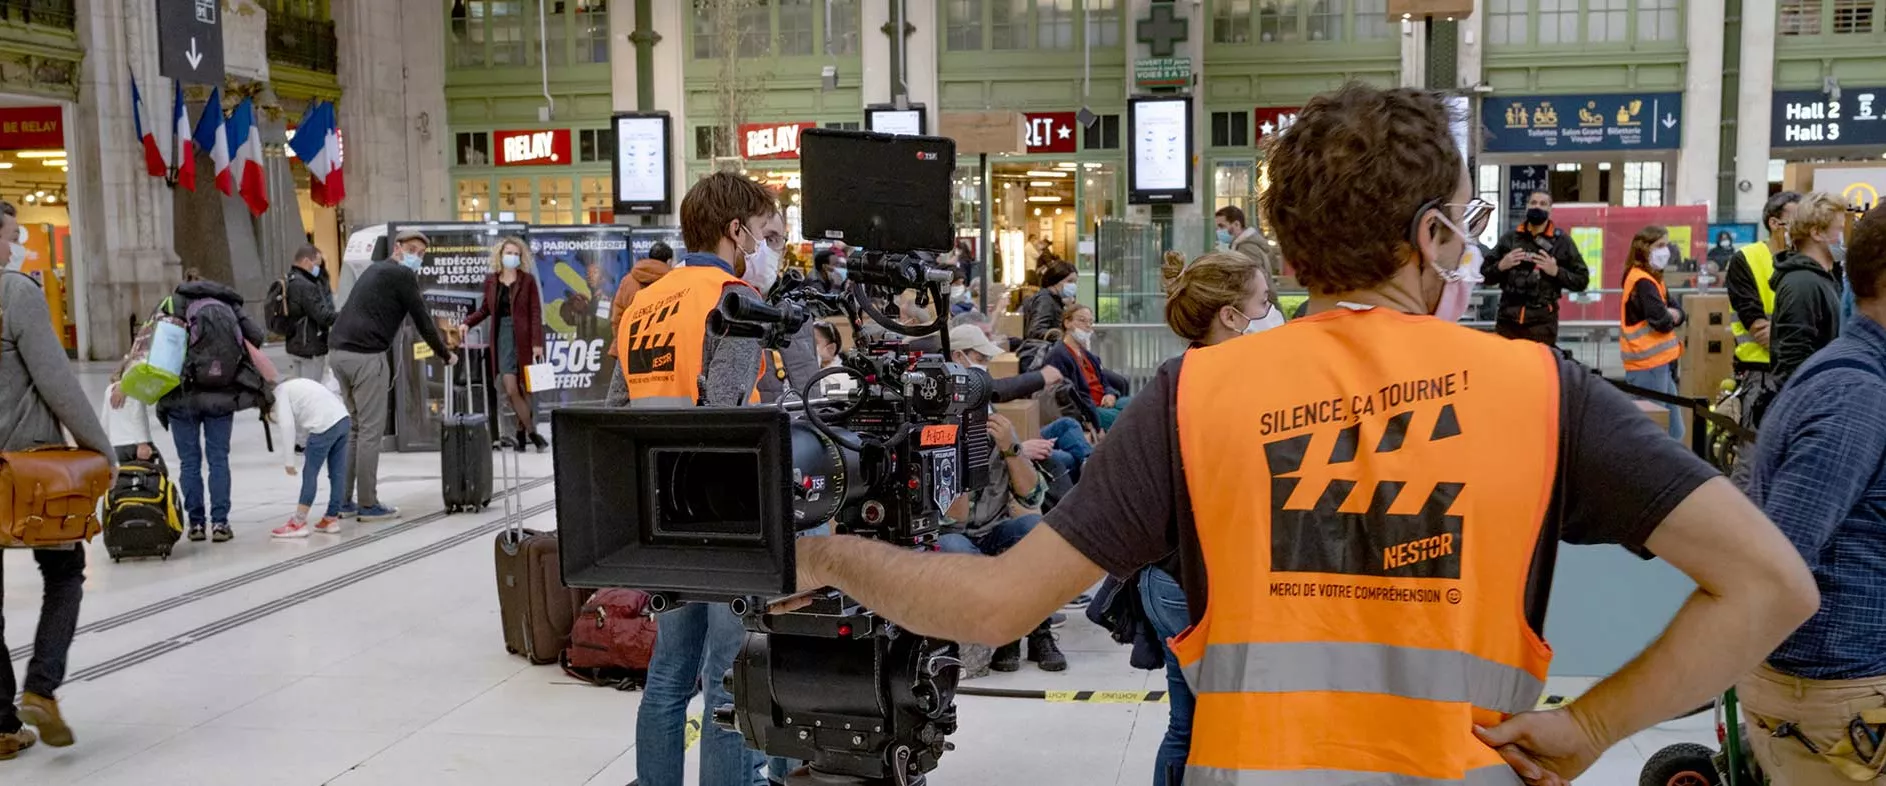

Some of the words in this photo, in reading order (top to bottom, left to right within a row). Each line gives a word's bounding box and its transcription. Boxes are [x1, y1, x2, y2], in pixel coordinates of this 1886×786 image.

[1786, 102, 1825, 120] Hall
[1827, 101, 1841, 119] 2
[21, 120, 57, 132] RELAY
[1561, 128, 1580, 136] Salon
[1581, 127, 1603, 136] Grand
[1528, 128, 1558, 137] Toilettes
[1785, 123, 1824, 142] Hall
[1826, 123, 1840, 140] 3
[1511, 179, 1535, 190] Hall
[1538, 179, 1546, 190] 2
[417, 266, 445, 275] TOUS
[447, 265, 465, 274] LES
[466, 265, 493, 273] ROMA
[436, 275, 449, 284] JR
[450, 275, 470, 283] DOS
[1259, 398, 1347, 436] SILENCE,
[1351, 395, 1375, 422] ÇA
[1379, 373, 1456, 411] TOURNE
[812, 478, 825, 489] TSF
[1383, 532, 1453, 570] NESTOR
[1270, 583, 1301, 597] MERCI
[1303, 583, 1316, 597] DE
[1319, 584, 1352, 598] VOTRE
[1354, 585, 1441, 602] COMPRÉHENSION
